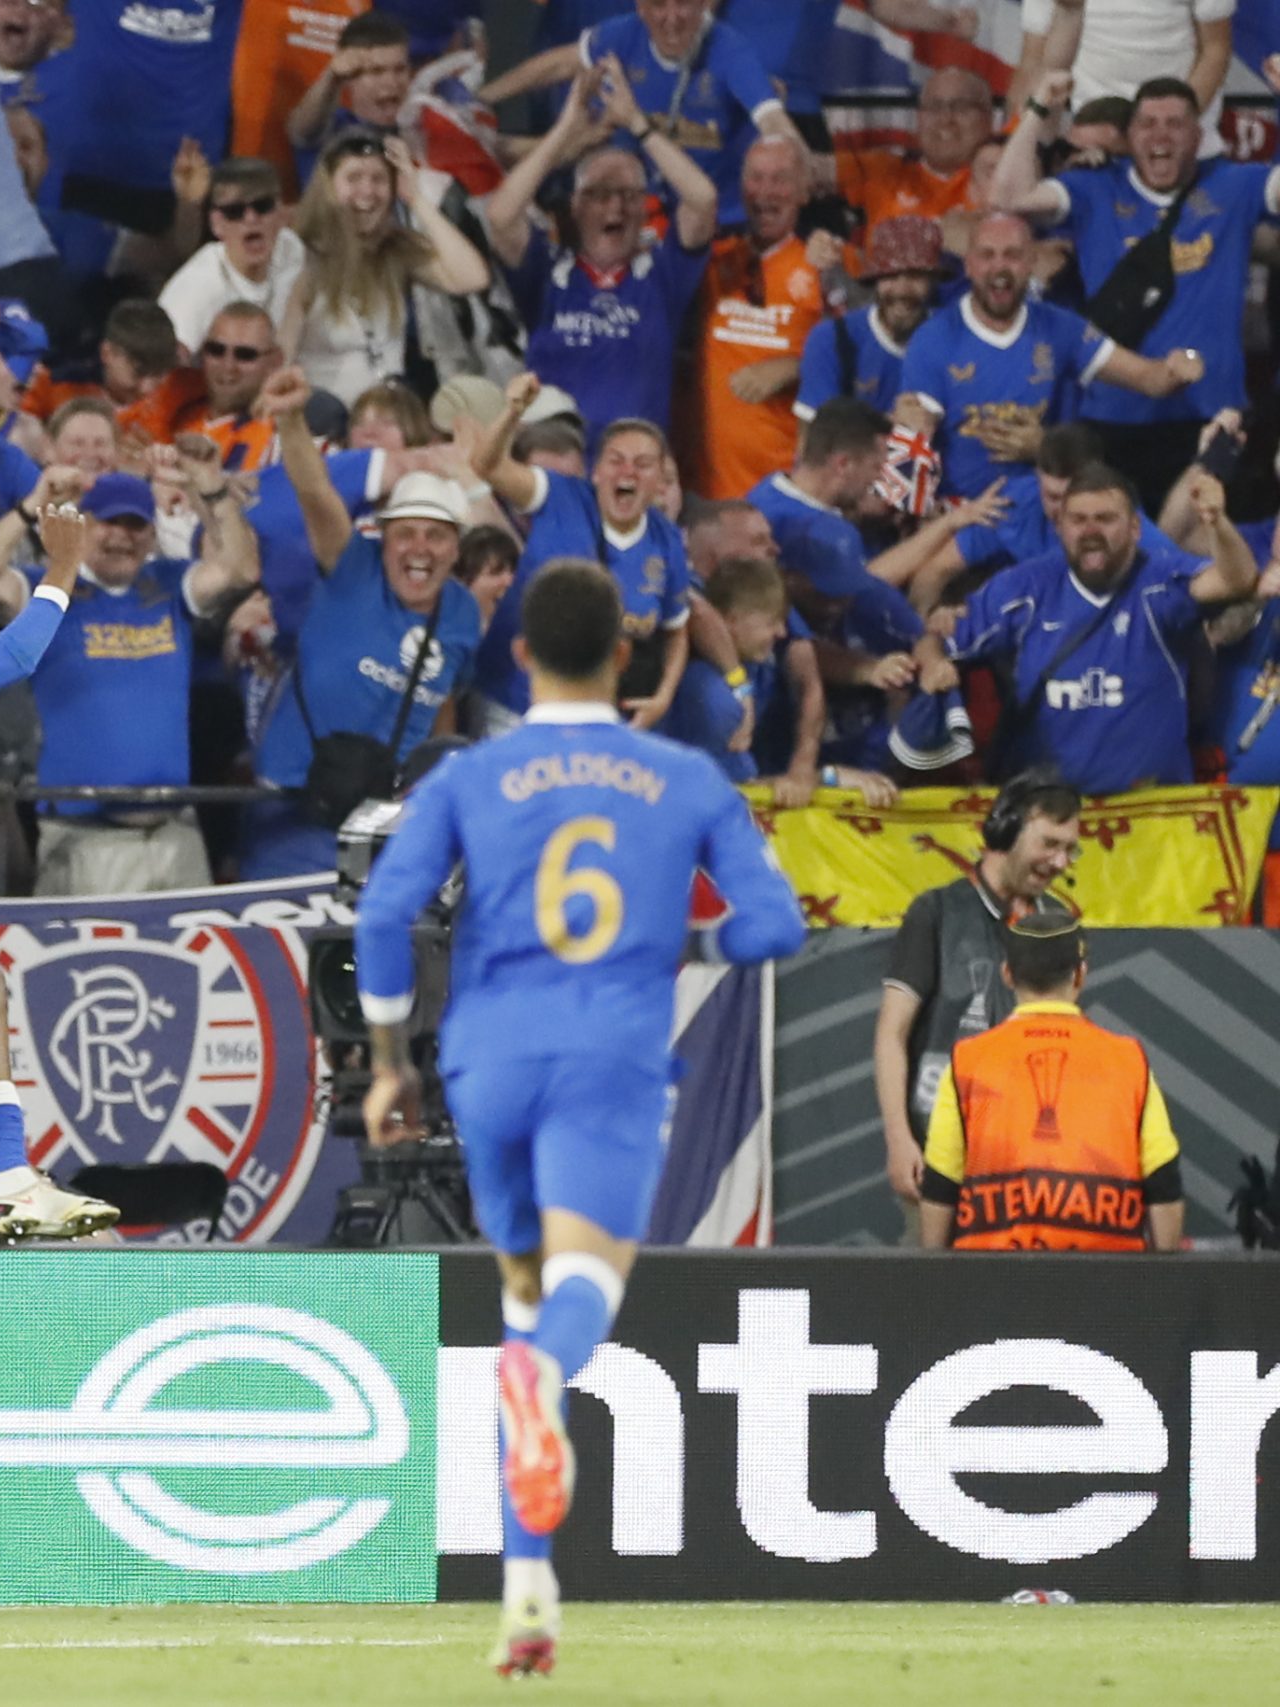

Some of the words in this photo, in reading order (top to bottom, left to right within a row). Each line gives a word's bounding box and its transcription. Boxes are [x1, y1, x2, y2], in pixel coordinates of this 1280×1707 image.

[500, 753, 667, 806] GOLDSON
[534, 813, 625, 966] 6
[204, 1042, 258, 1066] 1966
[957, 1177, 1145, 1229] STEWARD
